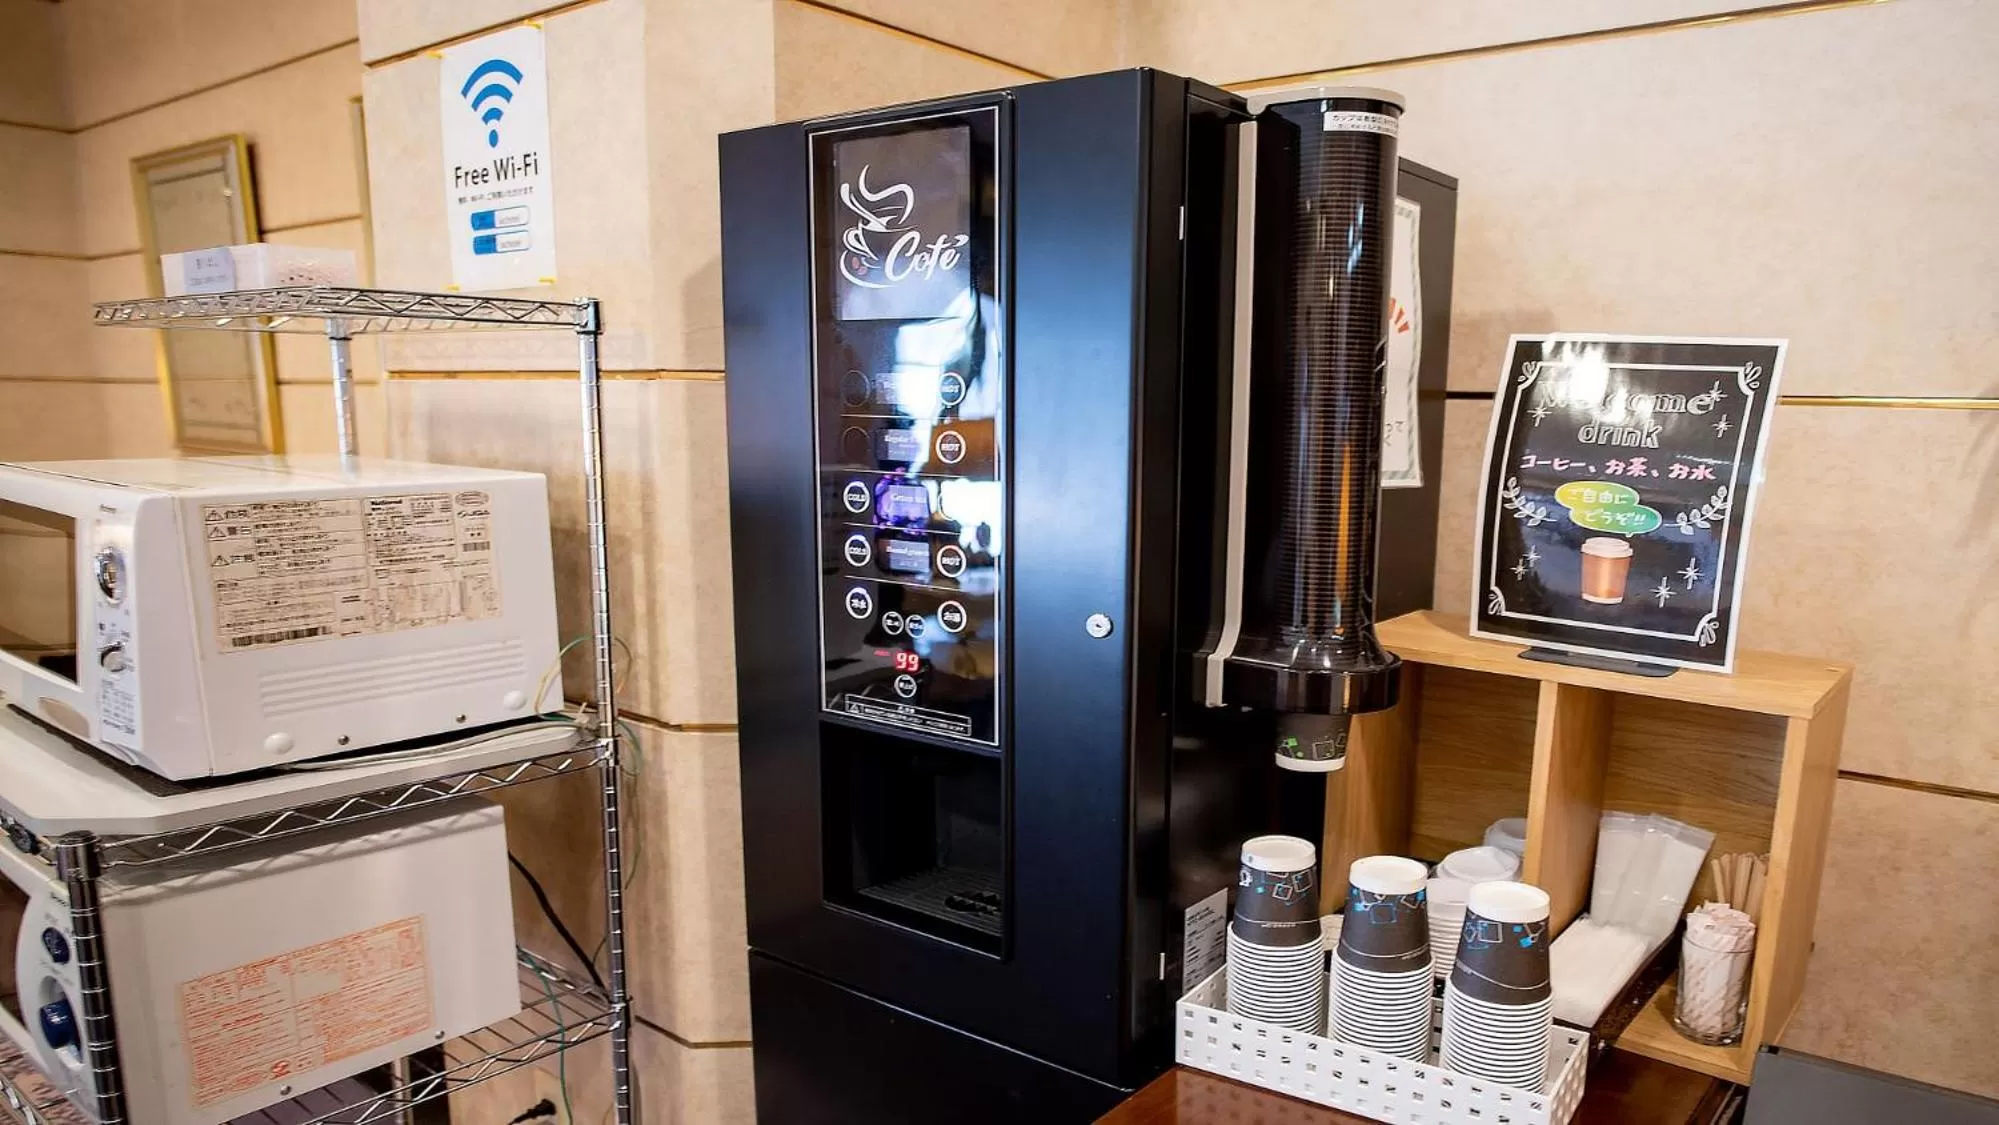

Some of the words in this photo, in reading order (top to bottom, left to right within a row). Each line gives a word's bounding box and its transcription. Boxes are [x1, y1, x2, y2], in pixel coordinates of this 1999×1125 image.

[454, 166, 489, 188] Free
[494, 152, 538, 181] Wi-Fi
[885, 231, 969, 282] Café
[1578, 414, 1663, 449] drink
[941, 443, 960, 452] HOT
[1519, 454, 1717, 481] コーヒー、お茶、お水
[847, 493, 866, 501] COLD
[1568, 487, 1630, 506] ご自由に
[849, 547, 867, 556] COLD
[942, 556, 961, 566] HOT
[896, 652, 919, 671] 99
